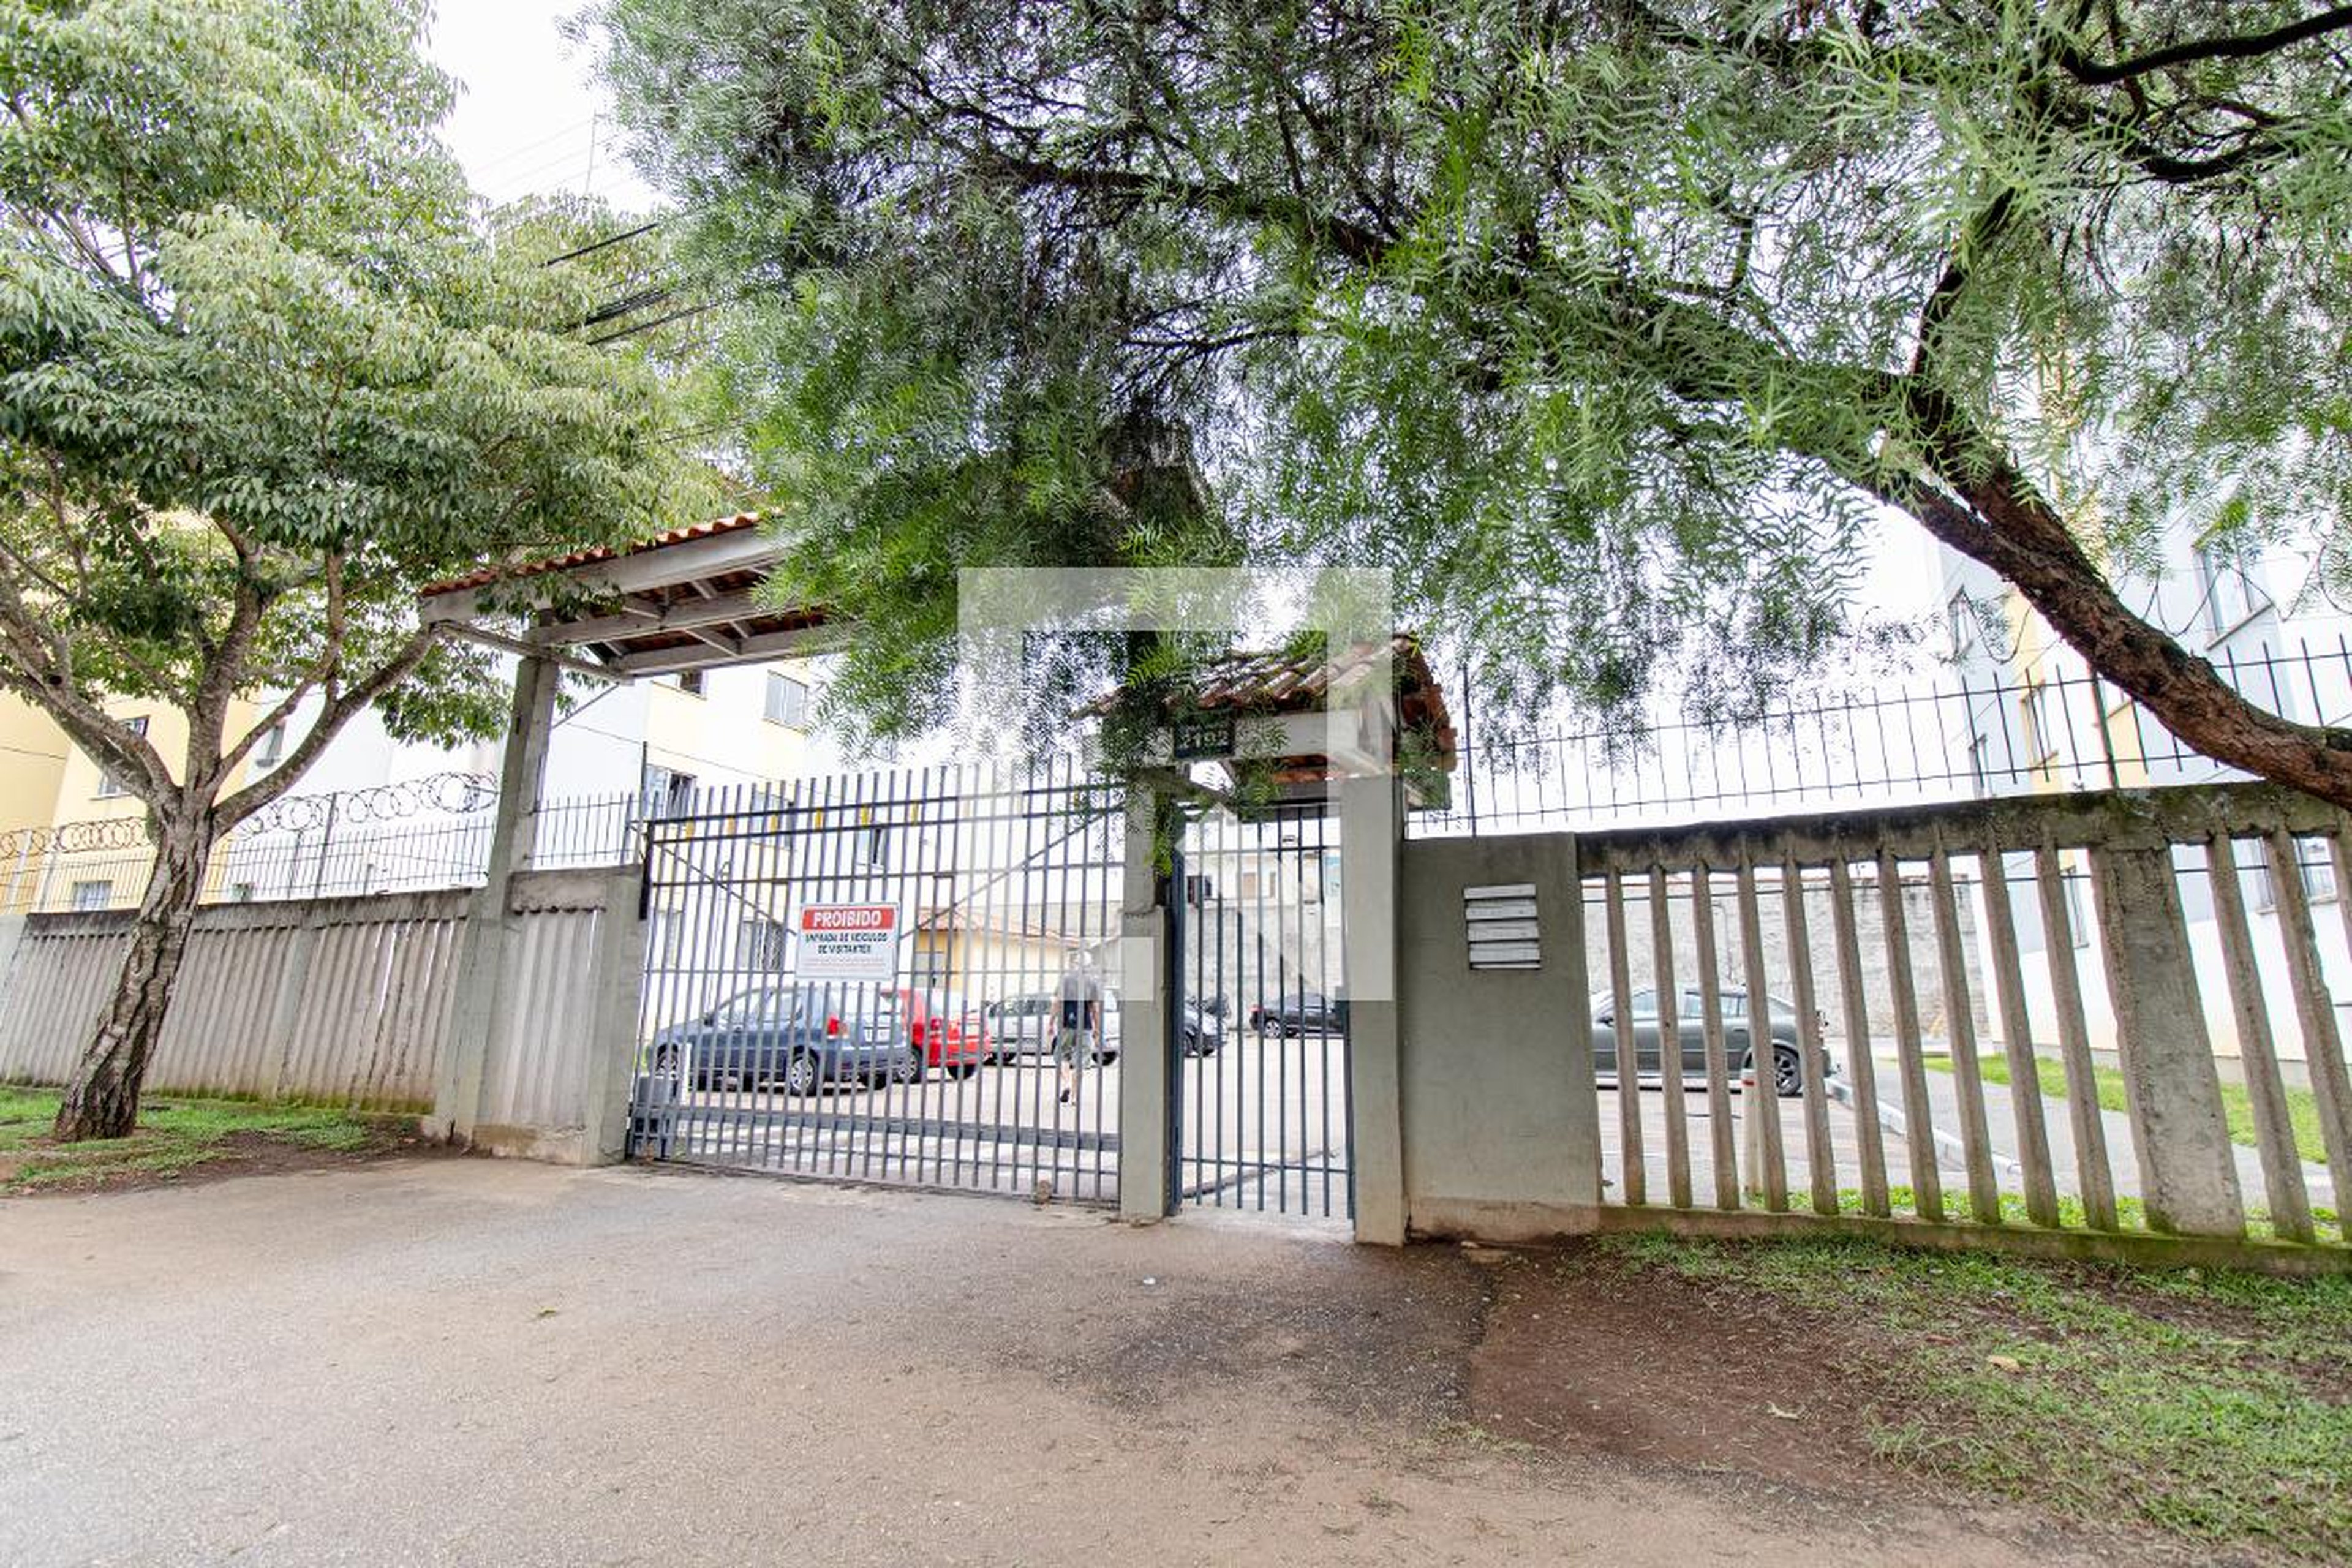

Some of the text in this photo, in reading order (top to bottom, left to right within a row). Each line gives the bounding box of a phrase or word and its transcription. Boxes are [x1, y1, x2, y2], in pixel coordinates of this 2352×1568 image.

[813, 910, 882, 927] PROIBIDO
[839, 932, 848, 942] DE
[818, 944, 827, 954] DE
